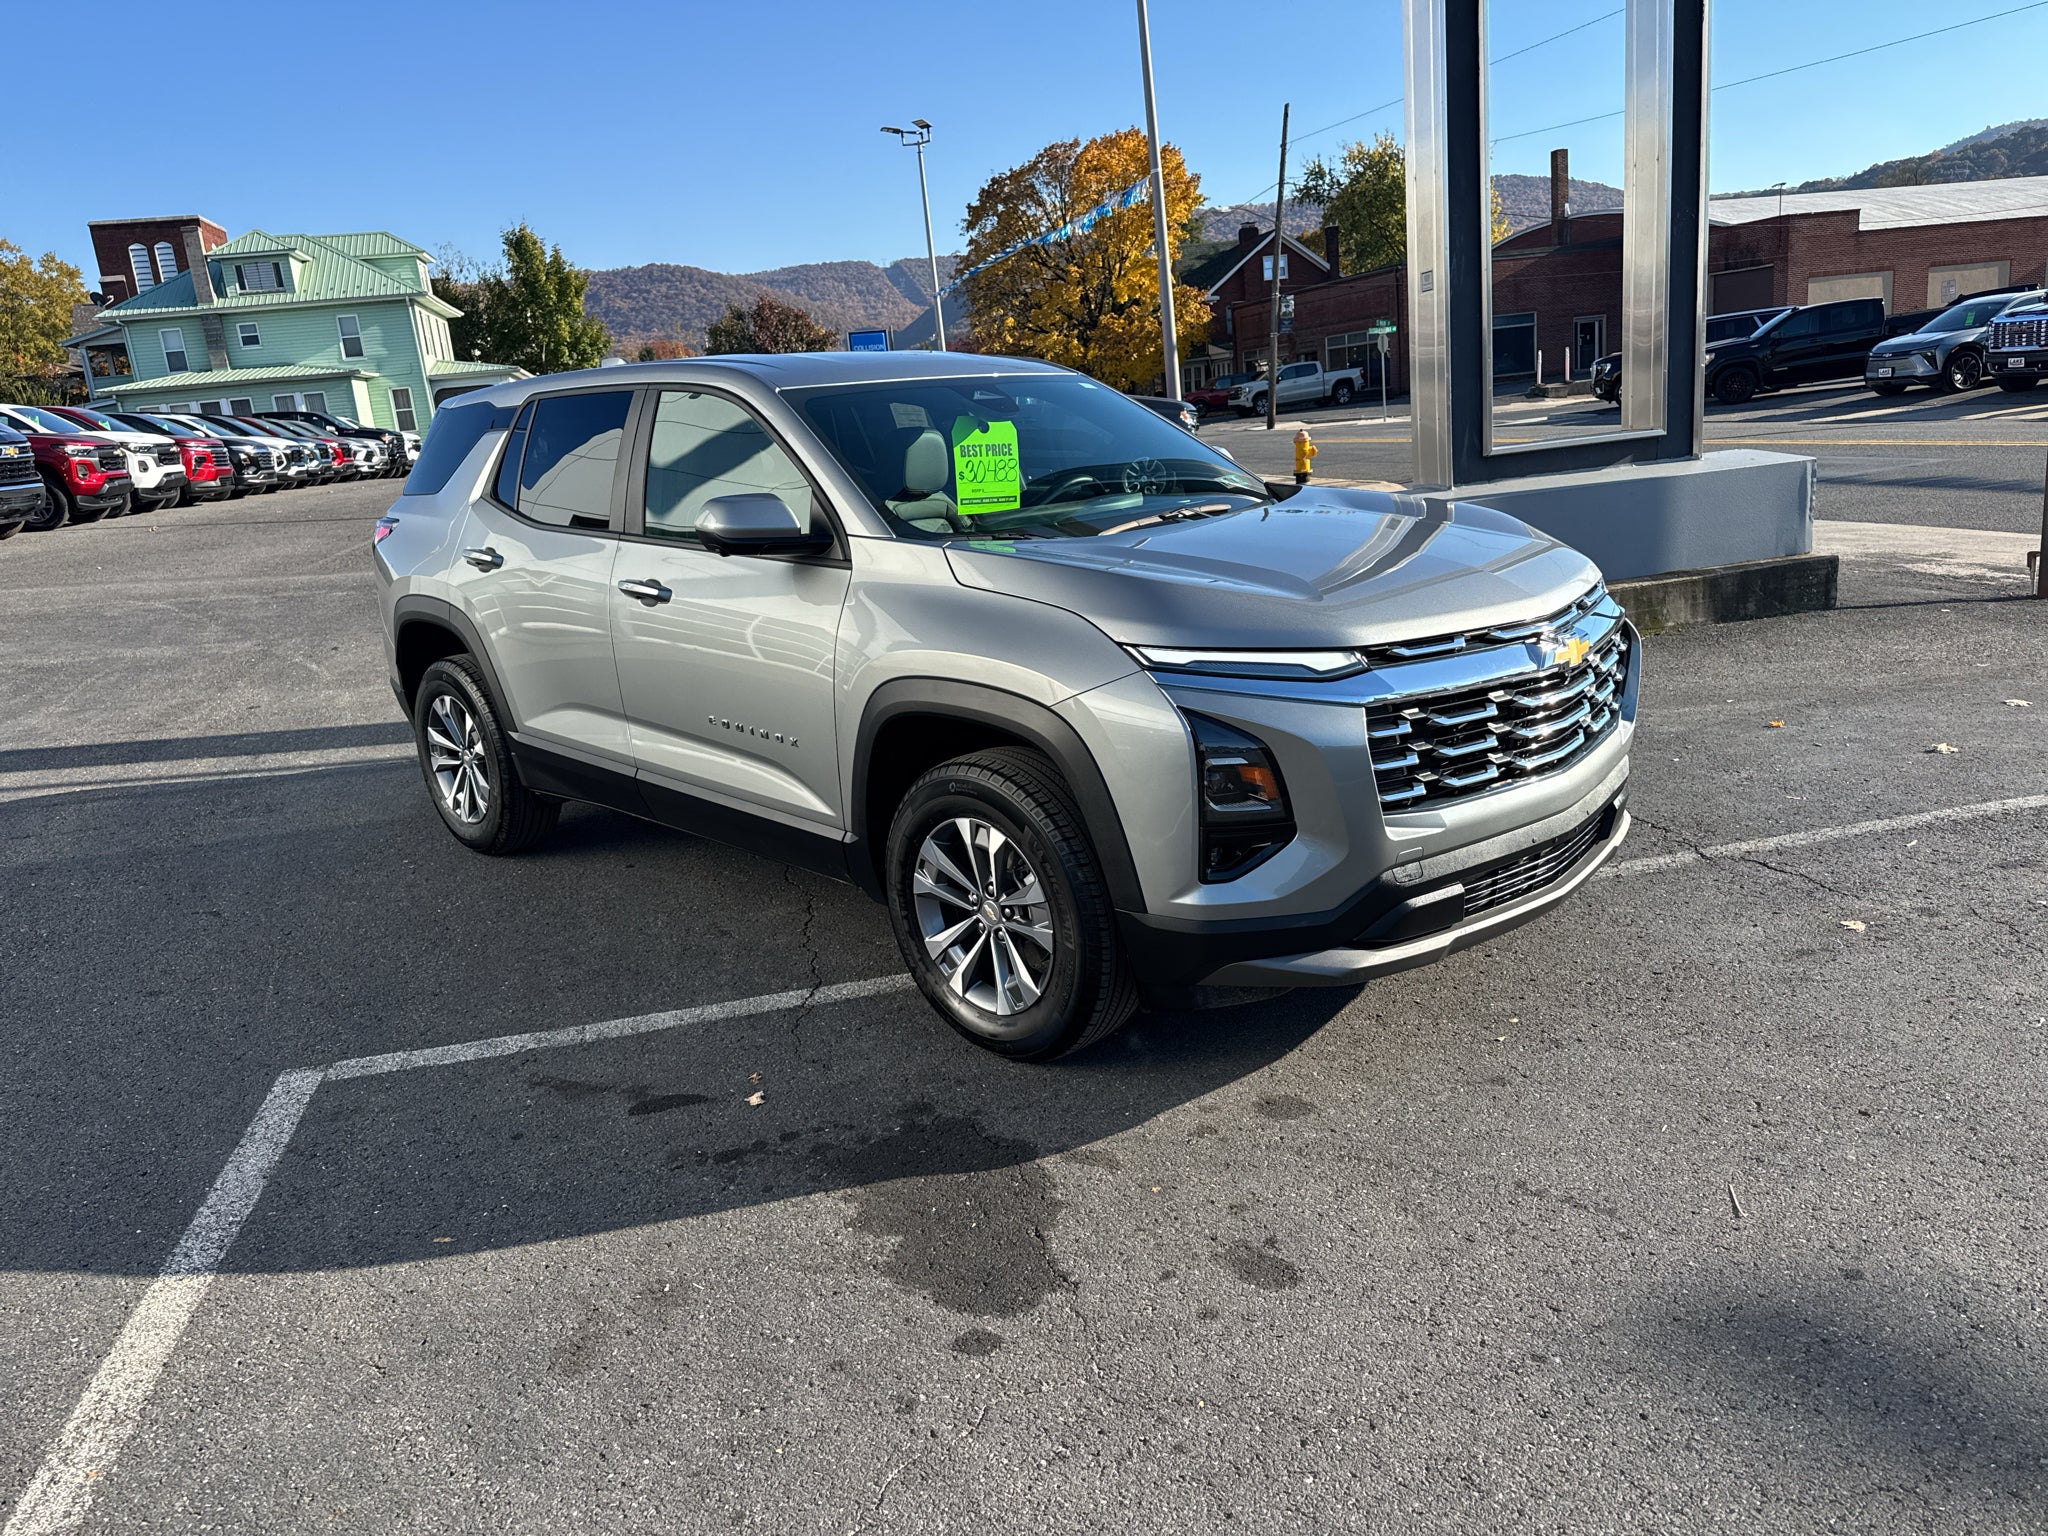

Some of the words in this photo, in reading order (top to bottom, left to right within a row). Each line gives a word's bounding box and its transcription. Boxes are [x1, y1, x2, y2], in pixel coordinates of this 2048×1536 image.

[853, 344, 885, 352] COLLISION
[960, 444, 983, 458] BEST
[985, 443, 1012, 457] PRICE
[708, 715, 799, 748] EQUINOX
